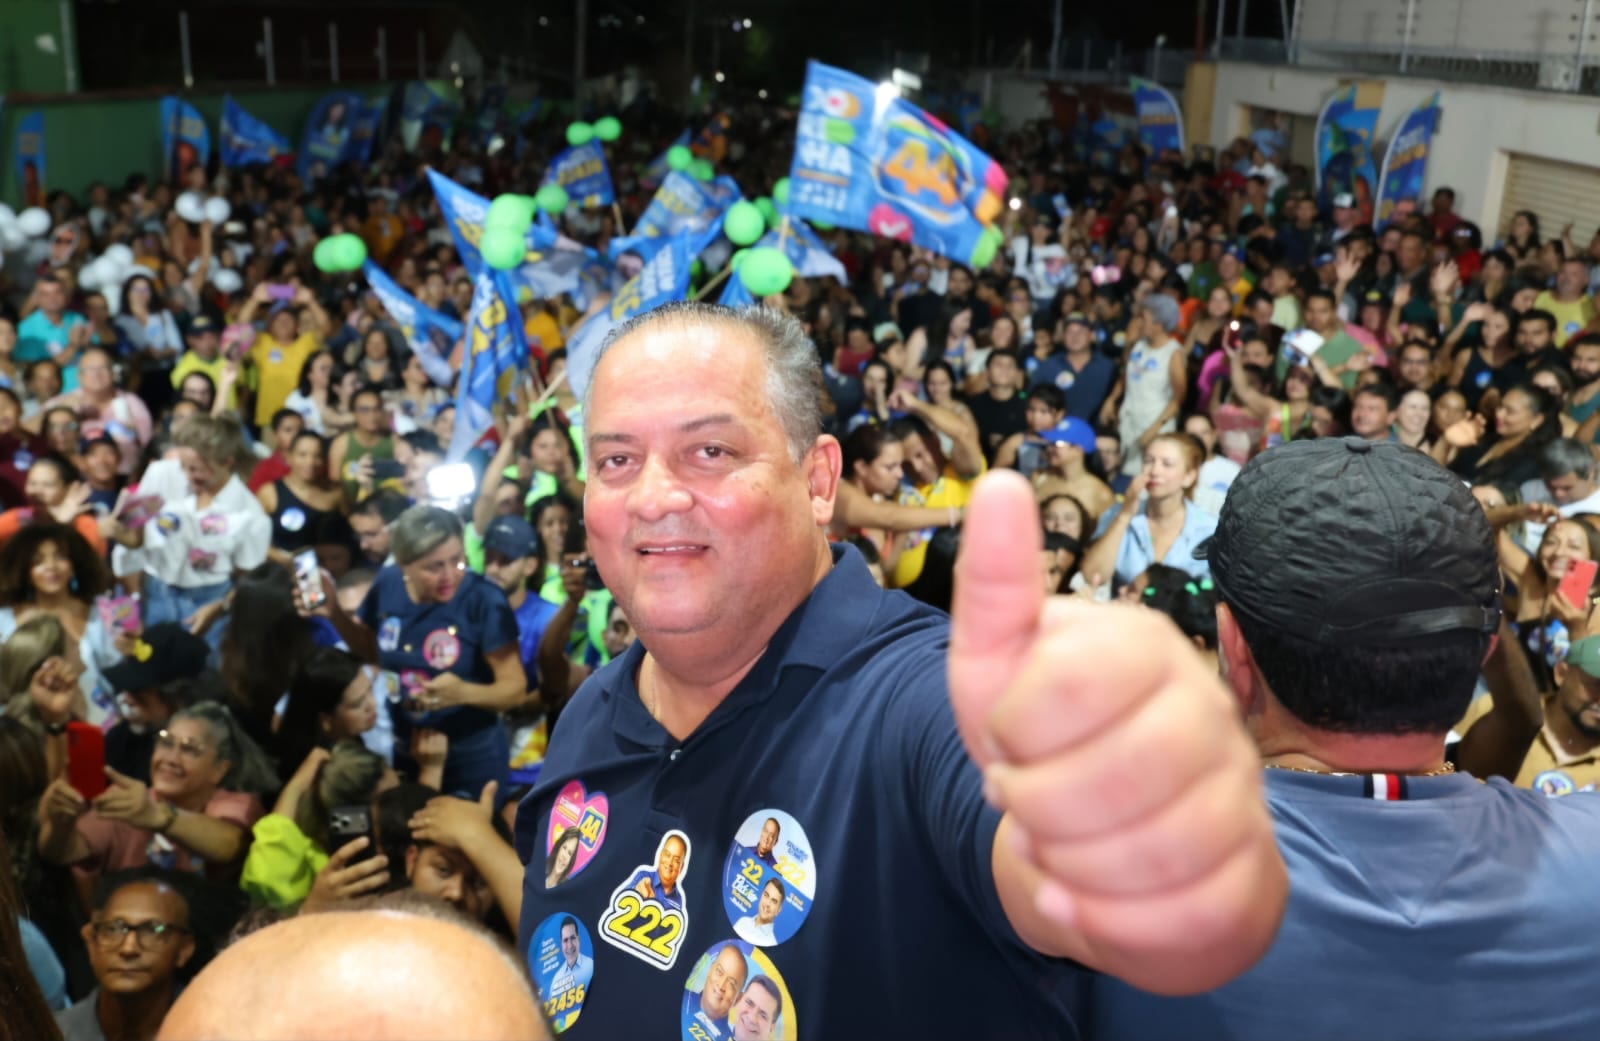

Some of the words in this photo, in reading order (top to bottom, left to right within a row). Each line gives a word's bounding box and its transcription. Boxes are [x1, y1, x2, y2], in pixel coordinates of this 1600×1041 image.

[884, 139, 959, 205] 44
[580, 815, 601, 843] 44
[742, 858, 763, 884] 22
[773, 855, 806, 887] 222
[608, 895, 681, 958] 222
